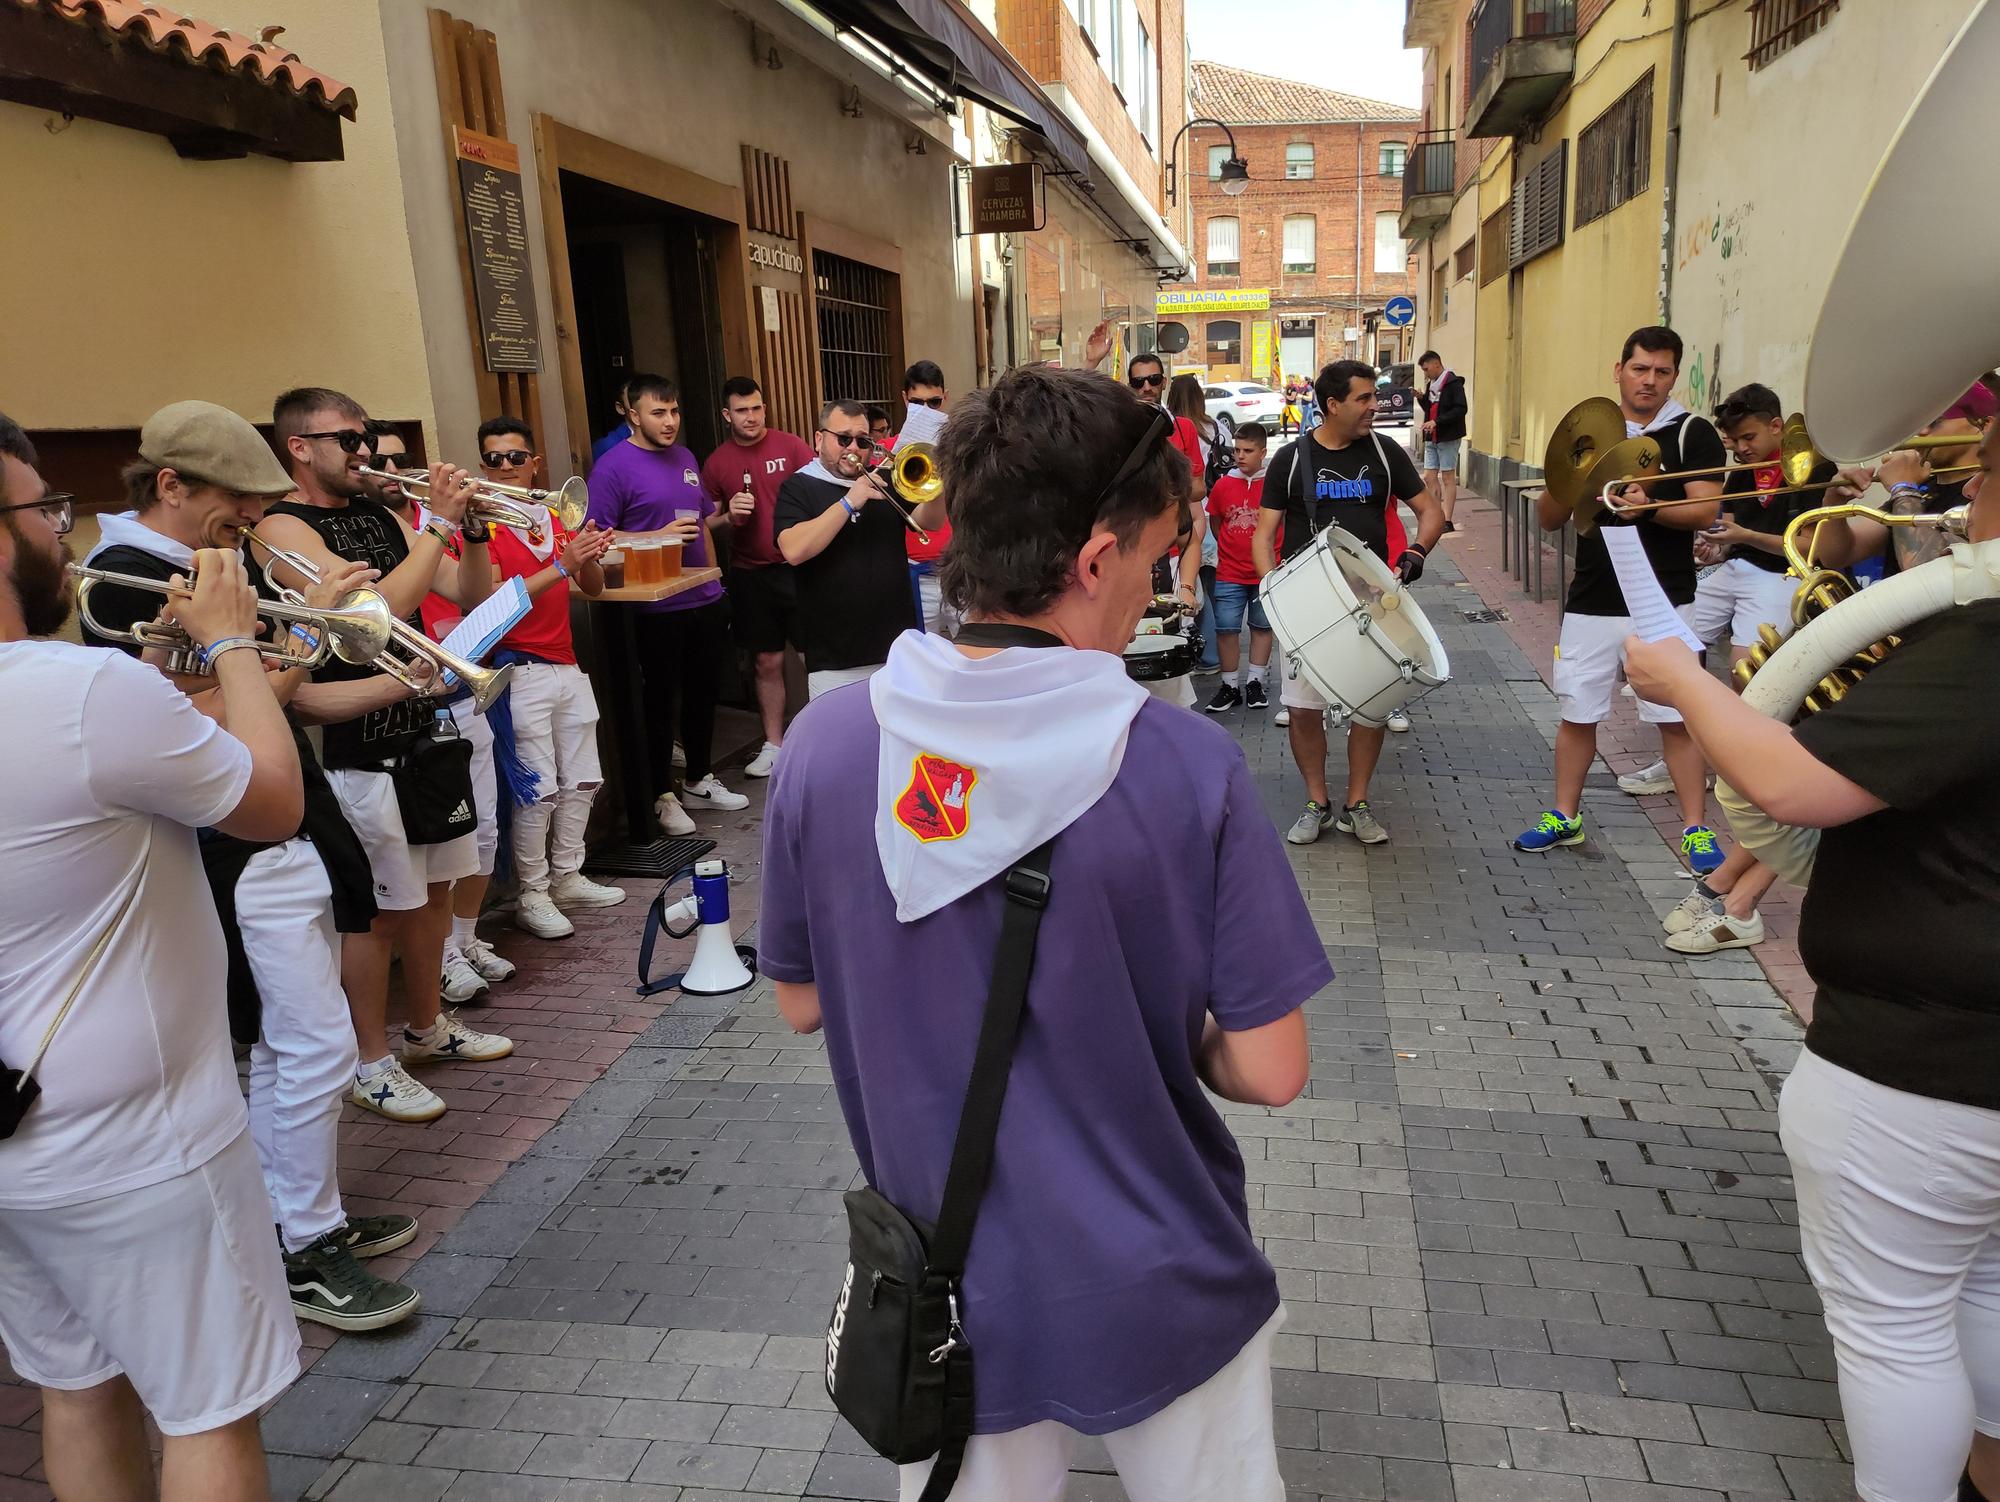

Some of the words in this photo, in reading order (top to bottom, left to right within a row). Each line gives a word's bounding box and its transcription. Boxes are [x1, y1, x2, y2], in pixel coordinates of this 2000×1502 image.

[982, 197, 1024, 209] CERVEZAS
[981, 209, 1027, 221] ALHAMBRA
[748, 242, 803, 273] capuchino
[765, 458, 786, 474] DT
[1316, 479, 1372, 498] PUMA
[448, 812, 472, 824] adidas
[827, 1261, 855, 1394] adidas
